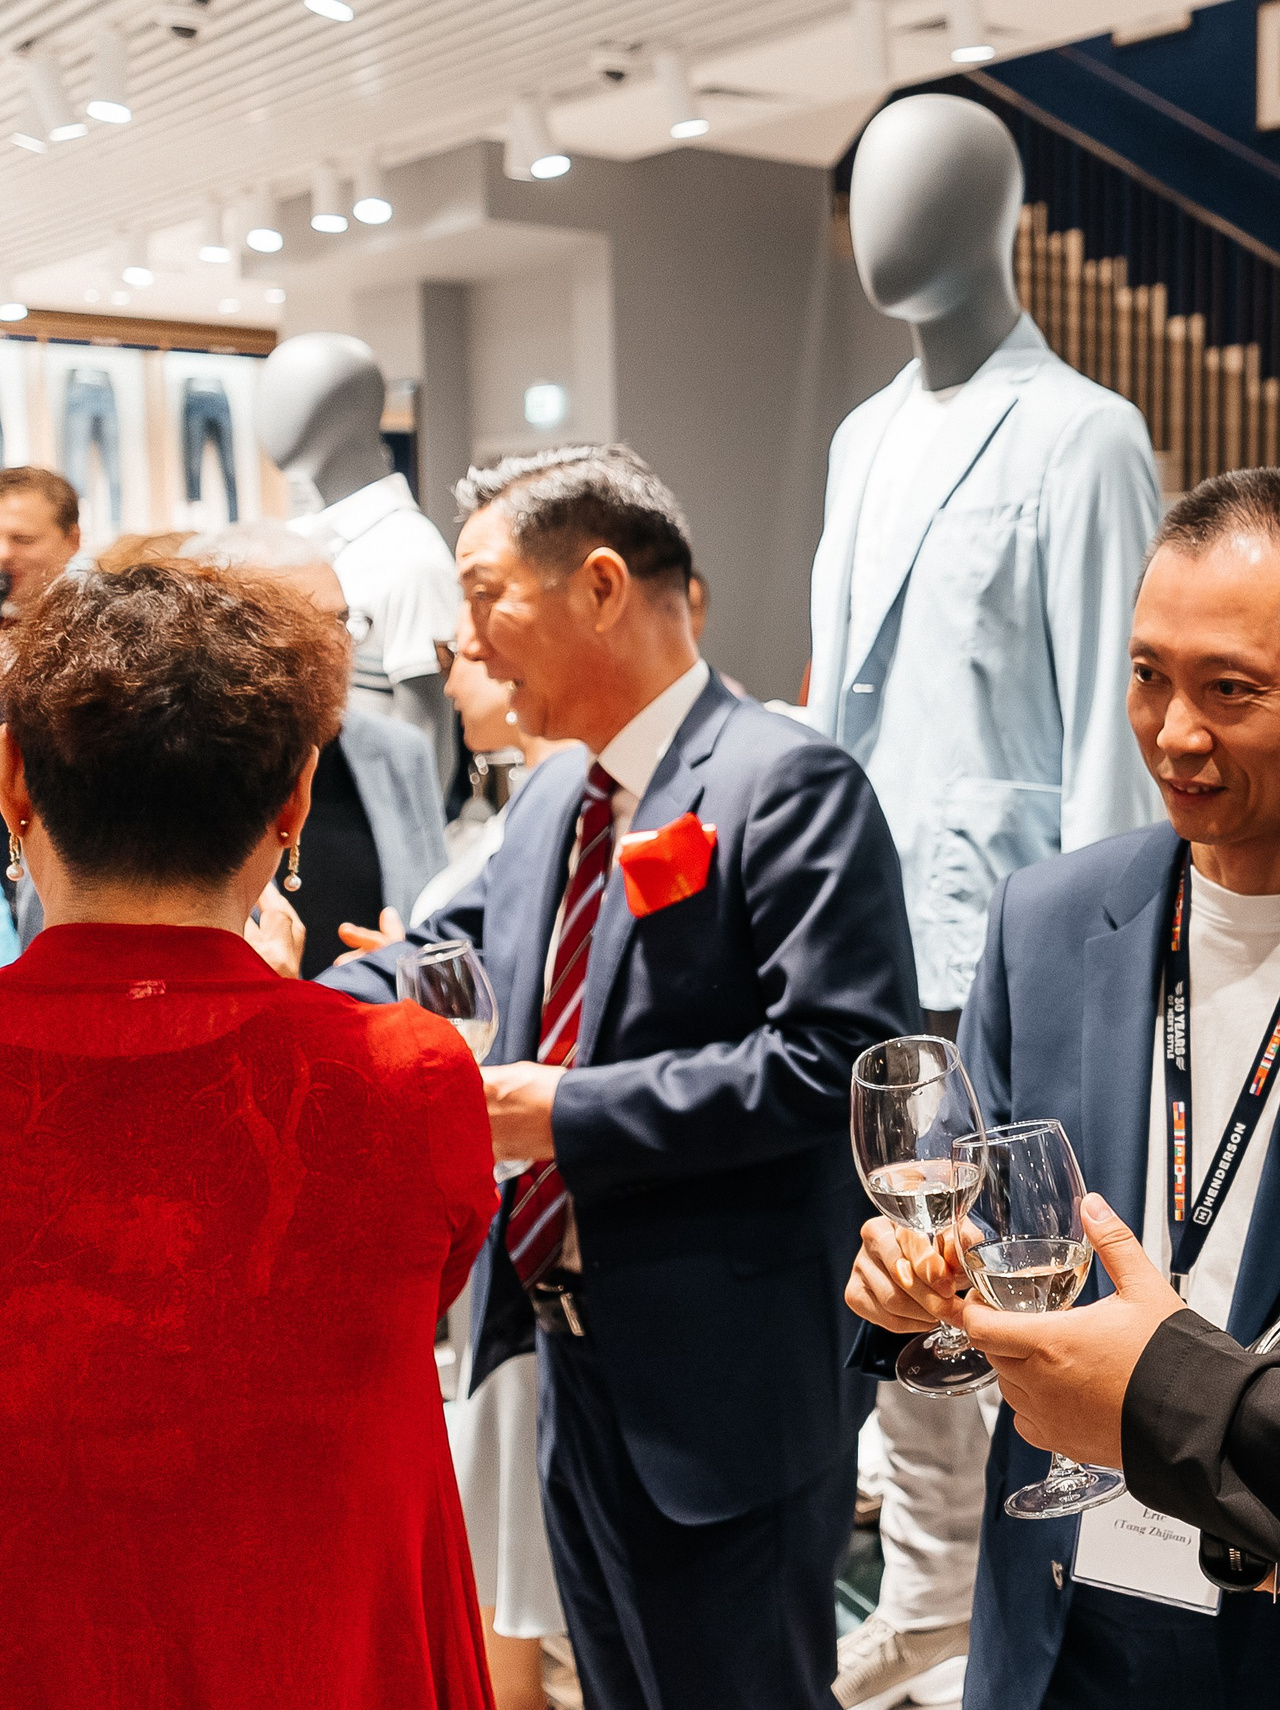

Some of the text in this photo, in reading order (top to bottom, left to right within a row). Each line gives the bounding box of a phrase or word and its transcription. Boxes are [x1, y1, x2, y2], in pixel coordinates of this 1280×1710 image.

[1166, 1033, 1175, 1059] STYLE
[1174, 996, 1186, 1056] 30 YEARS
[1203, 1122, 1247, 1207] HENDERSON
[1114, 1519, 1147, 1535] (Tang
